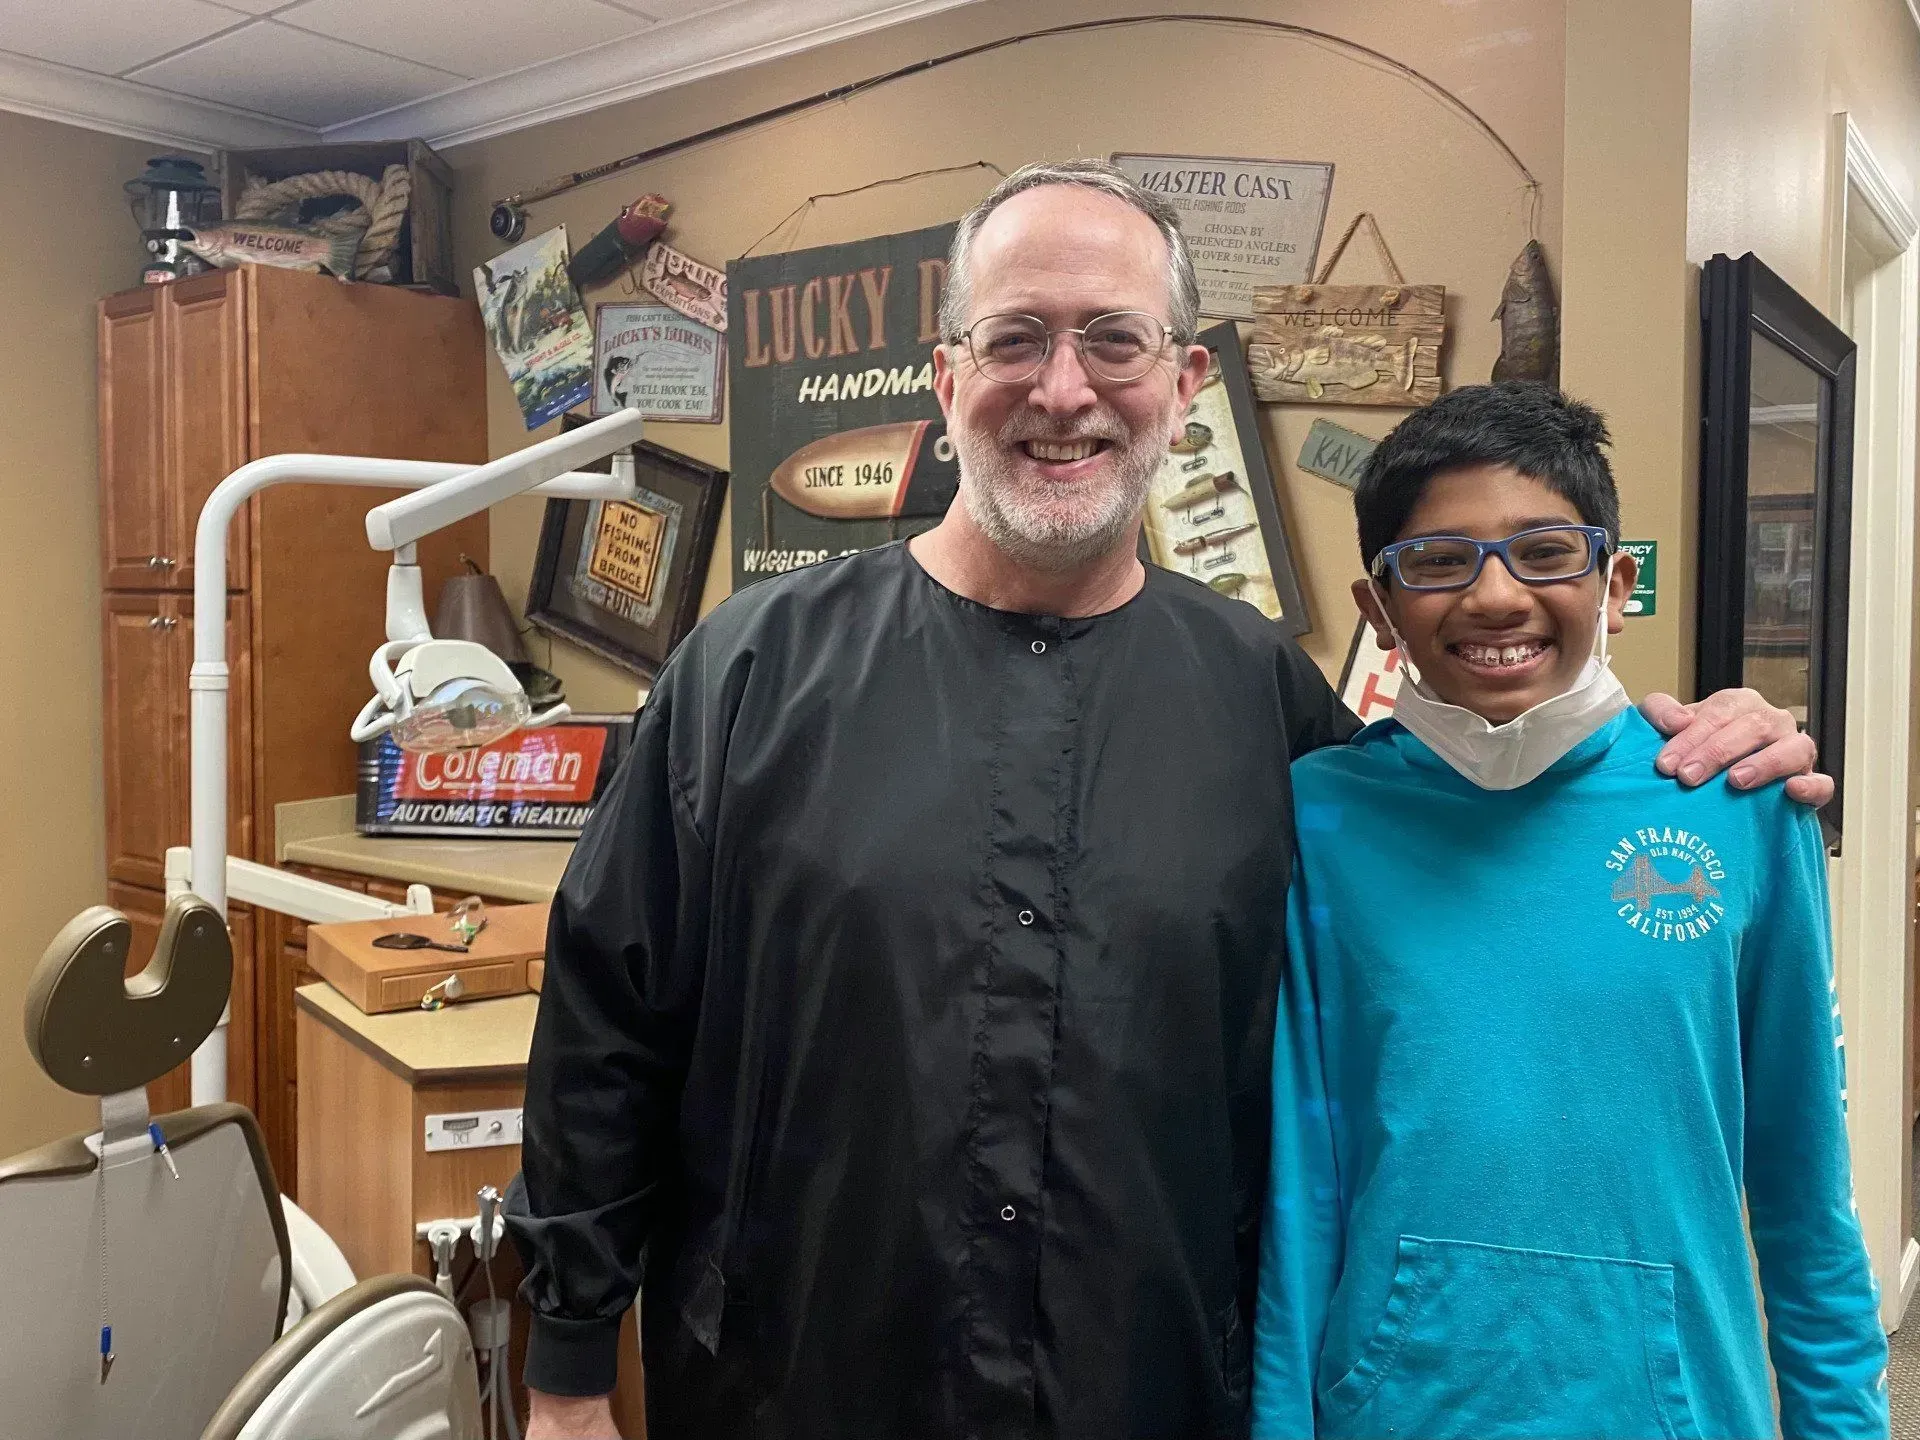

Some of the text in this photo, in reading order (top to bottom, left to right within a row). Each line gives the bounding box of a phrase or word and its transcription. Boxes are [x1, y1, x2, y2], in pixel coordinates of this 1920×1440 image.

[1138, 170, 1293, 200] MASTER CAST
[1193, 199, 1223, 212] FISHING
[1204, 223, 1265, 237] CHOSEN BY
[233, 231, 303, 254] WELCOME
[1245, 241, 1297, 254] ANGLERS
[1202, 250, 1230, 262] OVER
[1233, 253, 1244, 263] 50
[1246, 253, 1281, 267] YEARS
[743, 264, 893, 368] LUCKY
[1283, 307, 1400, 328] WELCOME
[603, 326, 661, 354] LUCKY'S
[664, 326, 713, 355] LURES
[660, 384, 688, 396] HOOK
[798, 362, 933, 403] HANDMA
[637, 399, 655, 409] YOU
[656, 399, 681, 410] COOK
[805, 461, 893, 488] SINCE 1946
[620, 511, 638, 530] NO
[603, 524, 652, 554] FISHING
[607, 543, 640, 568] FROM
[599, 559, 642, 589] BRIDGE
[604, 586, 634, 618] FUN
[416, 748, 582, 791] Coleman
[390, 804, 594, 826] AUTOMATIC HEATIN
[1605, 826, 1725, 880] SAN FRANCISCO
[1649, 846, 1697, 866] OLD NAVY
[1617, 901, 1725, 942] CALIFORNIA
[1654, 904, 1700, 920] EST 1994
